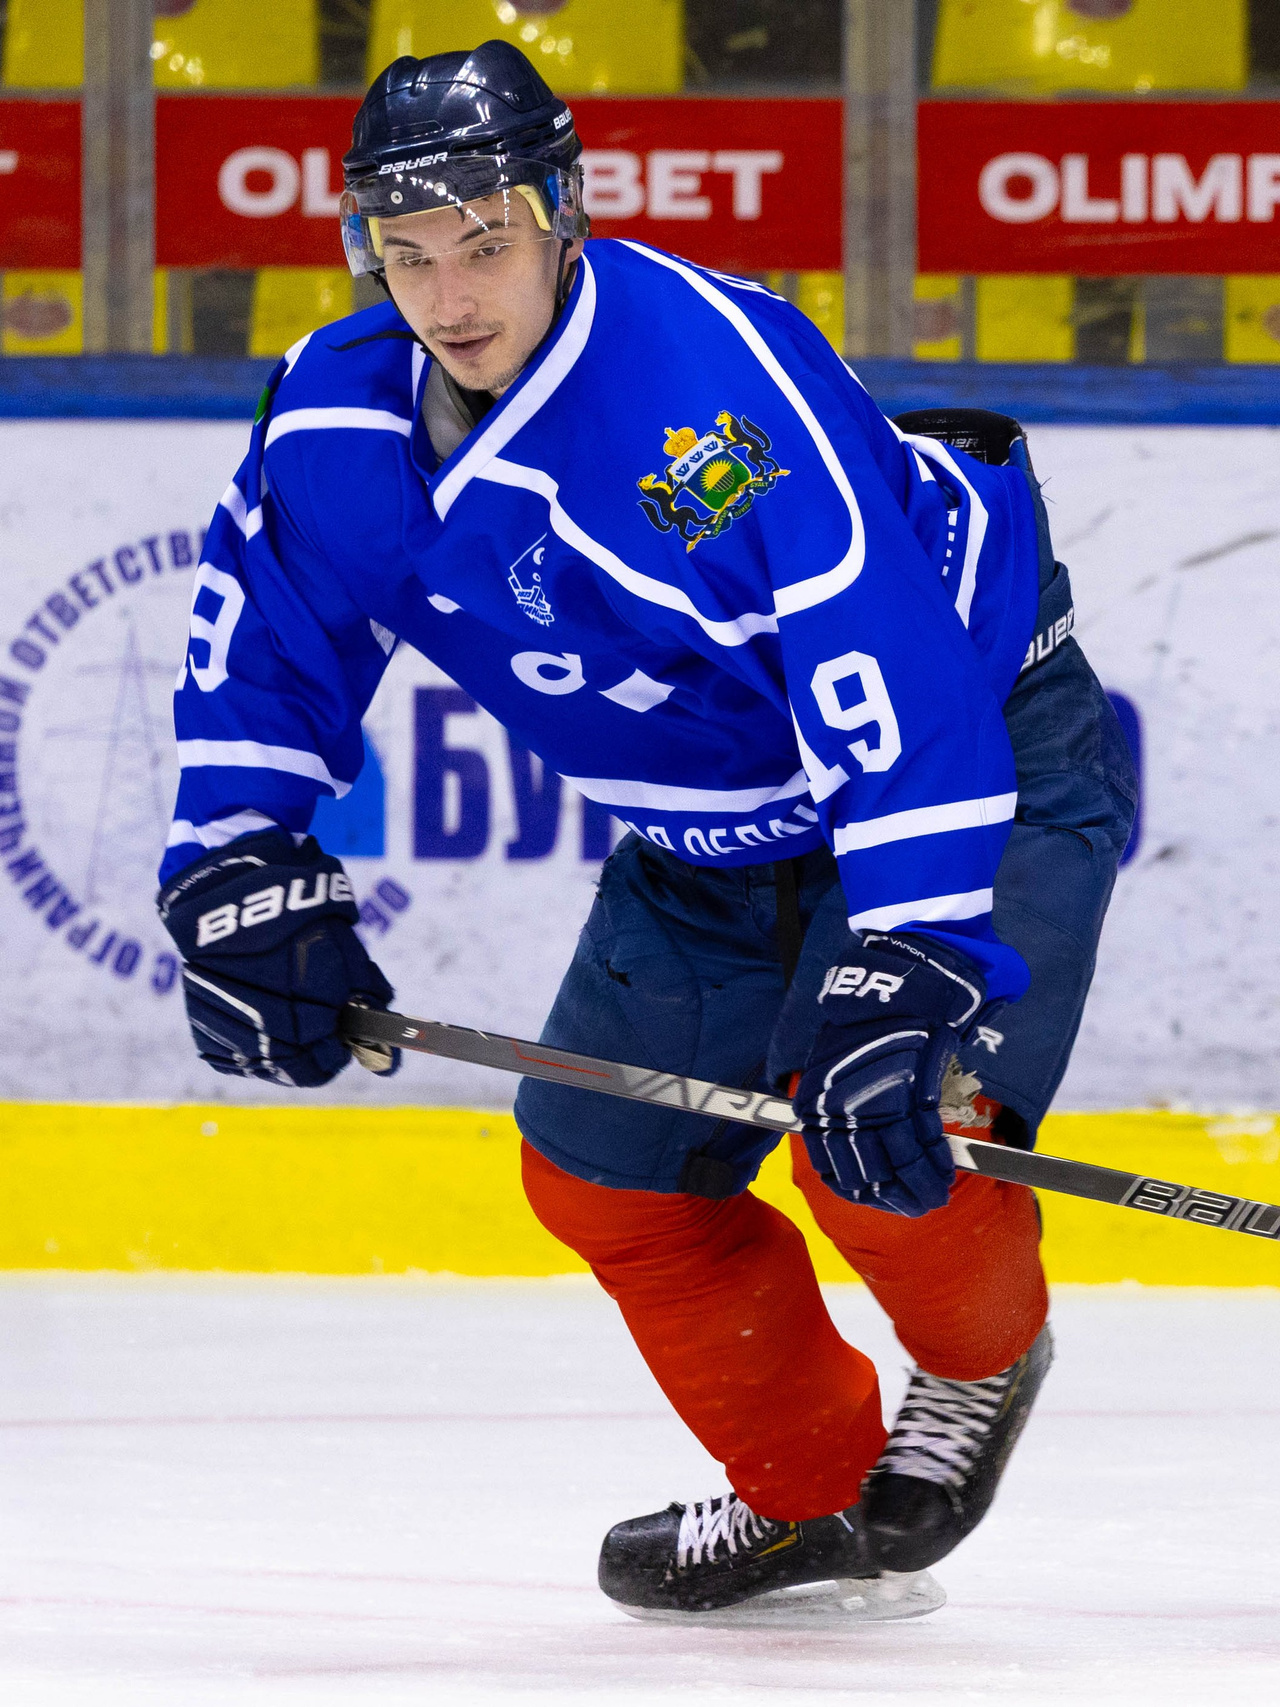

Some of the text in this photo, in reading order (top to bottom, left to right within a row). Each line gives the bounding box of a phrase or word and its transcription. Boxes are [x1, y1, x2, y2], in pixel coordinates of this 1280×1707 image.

[218, 146, 783, 220] OLBET
[378, 151, 448, 176] BAUER
[196, 872, 356, 948] BAUE
[890, 937, 927, 962] VAPOR
[617, 1066, 805, 1129] VAPO
